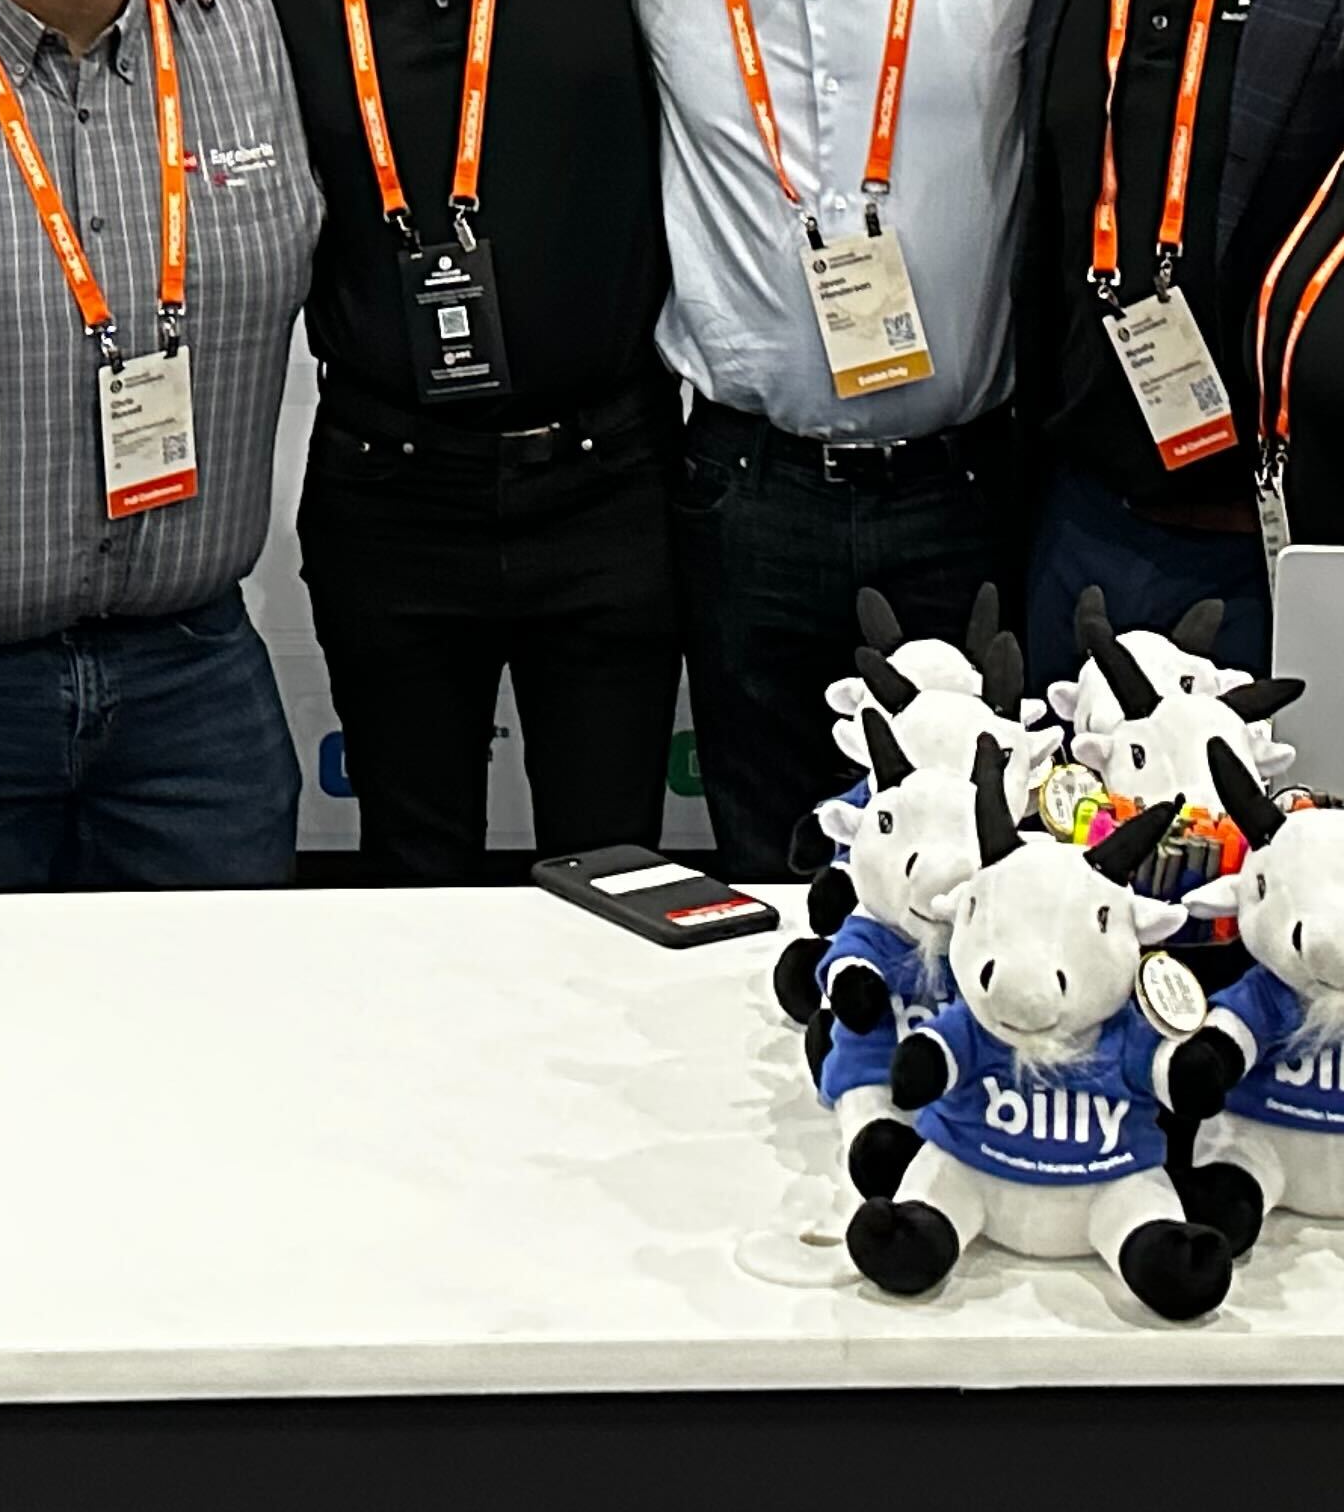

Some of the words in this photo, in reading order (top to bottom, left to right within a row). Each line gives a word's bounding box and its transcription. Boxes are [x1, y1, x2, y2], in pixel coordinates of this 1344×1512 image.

[878, 65, 899, 140] PROCORE
[8, 119, 47, 191] PROCORE
[49, 212, 88, 285] PROCORE
[982, 1076, 1131, 1155] billy
